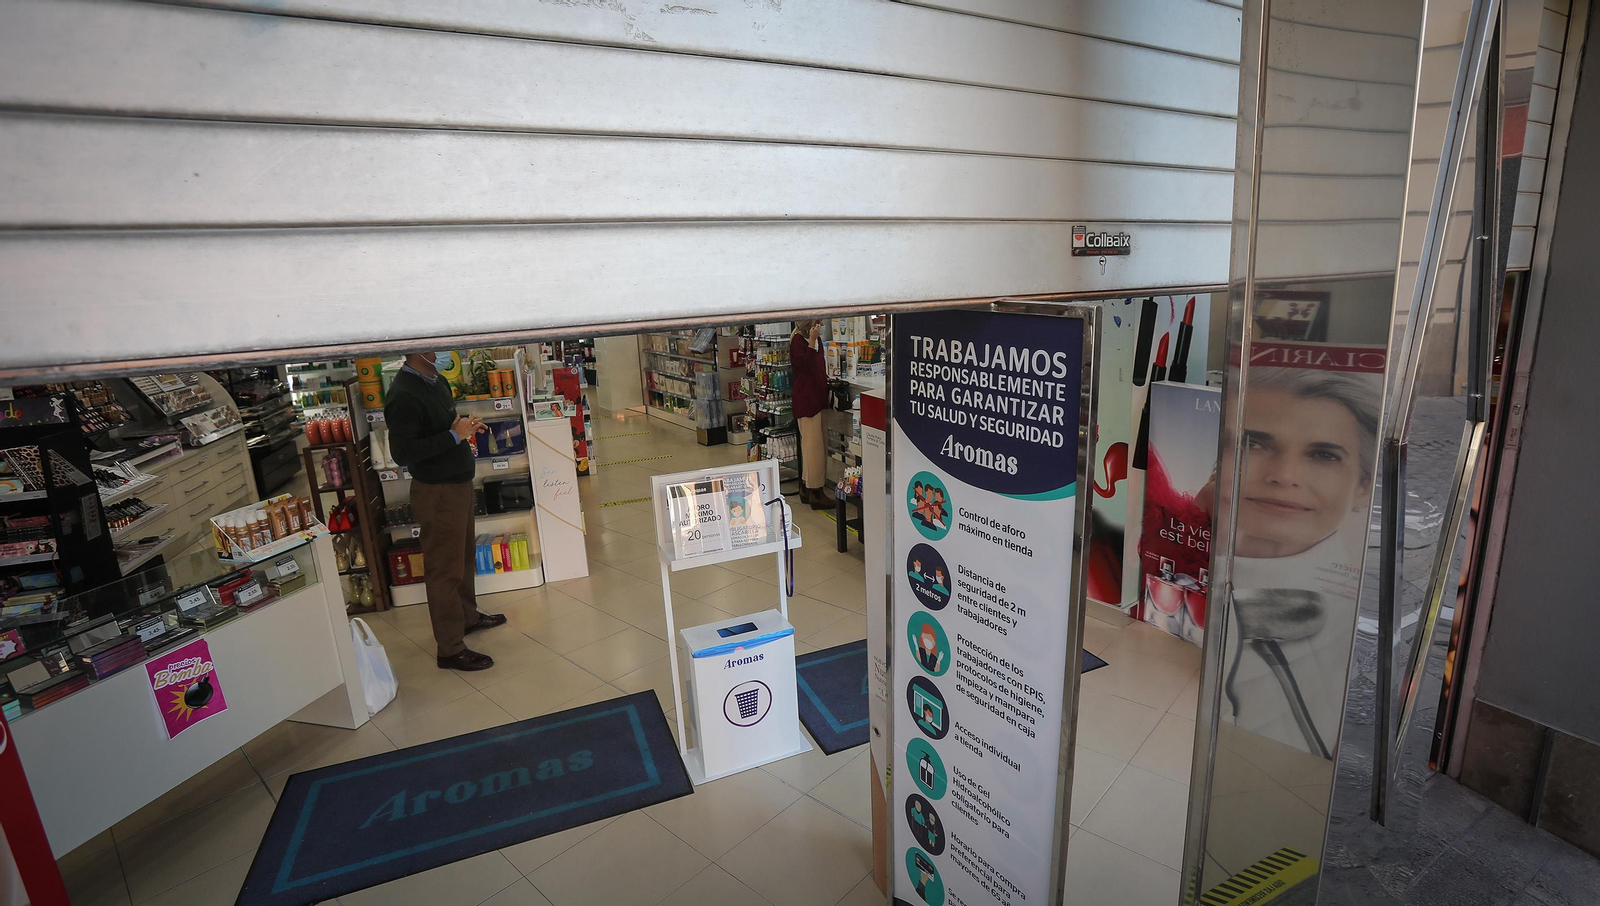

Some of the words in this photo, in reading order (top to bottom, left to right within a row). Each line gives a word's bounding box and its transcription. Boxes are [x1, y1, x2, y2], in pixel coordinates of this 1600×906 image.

[1086, 233, 1129, 247] CollBaix
[910, 335, 1067, 379] TRABAJAMOS
[910, 361, 1065, 402] RESPONSABLEMENTE
[910, 379, 945, 402] PARA
[951, 387, 1064, 426] GARANTIZAR
[910, 400, 925, 416] TU
[928, 404, 967, 425] SALUD
[969, 413, 977, 428] Y
[979, 415, 1064, 448] SEGURIDAD
[940, 434, 1018, 475] Aromas
[543, 479, 569, 488] listen
[553, 486, 572, 500] feel
[687, 529, 701, 541] 20
[958, 522, 991, 541] máximo
[992, 535, 1003, 546] en
[1004, 537, 1033, 557] tienda
[959, 507, 988, 525] Control
[990, 519, 1000, 530] de
[1002, 523, 1026, 540] aforo
[1160, 528, 1183, 544] est
[1188, 535, 1209, 552] bel
[1170, 517, 1185, 532] La
[1190, 526, 1210, 540] vie
[916, 583, 921, 591] 2
[920, 585, 942, 603] metros
[958, 564, 993, 588] Distancia
[995, 581, 1006, 593] de
[957, 579, 997, 603] seguridad
[998, 597, 1009, 609] de
[1010, 601, 1016, 613] 2
[1017, 607, 1026, 617] m
[957, 591, 978, 608] entre
[979, 601, 1011, 624] clientes
[1012, 618, 1018, 628] y
[957, 604, 1008, 636] trabajadores
[154, 658, 212, 689] Bomba
[168, 658, 199, 672] precios
[723, 653, 764, 670] Aromas
[957, 633, 998, 663] Protección
[999, 658, 1010, 669] de
[1011, 663, 1024, 677] los
[956, 660, 998, 689] protocolos
[998, 684, 1009, 696] de
[1010, 690, 1045, 718] higiene,
[957, 646, 1006, 681] trabajadores
[1006, 676, 1023, 690] con
[1024, 684, 1046, 705] EPIS,
[956, 670, 988, 696] limpieza
[989, 691, 994, 700] y
[994, 695, 1035, 725] mampara
[956, 683, 966, 695] de
[966, 690, 1005, 720] seguridad
[1006, 716, 1017, 727] en
[1017, 722, 1036, 739] caja
[954, 721, 981, 744] Acceso
[981, 738, 1021, 772] individual
[959, 736, 983, 758] tienda
[359, 748, 596, 829] Aromas
[953, 765, 967, 781] Uso
[967, 778, 977, 789] de
[977, 784, 990, 799] Gel
[951, 800, 979, 826] clientes
[951, 789, 991, 824] obligatorio
[992, 821, 1010, 839] para
[952, 777, 1011, 827] Hidroalcohólico
[950, 843, 993, 883] preferencial
[993, 880, 1011, 899] para
[950, 853, 980, 883] mayores
[980, 880, 991, 890] de
[991, 889, 1001, 901] 65
[951, 831, 977, 858] Horario
[978, 856, 995, 874] para
[995, 871, 1026, 900] compra
[948, 888, 956, 899] Se
